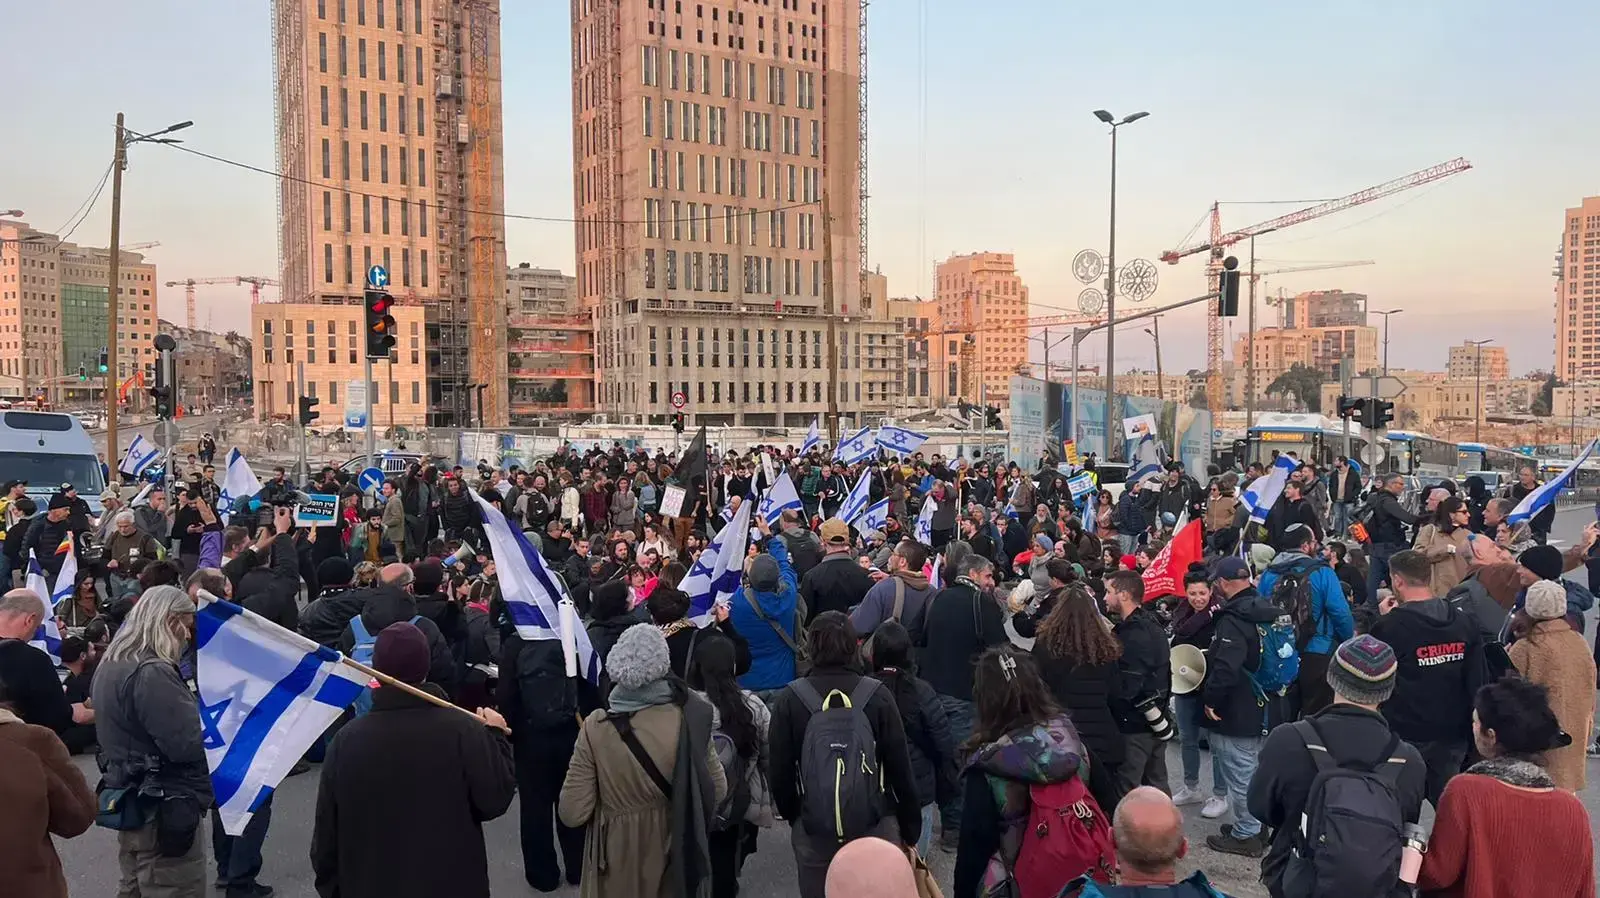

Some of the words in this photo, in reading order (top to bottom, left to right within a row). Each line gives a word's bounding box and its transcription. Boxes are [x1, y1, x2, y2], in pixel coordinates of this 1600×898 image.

[675, 396, 682, 405] 30
[168, 480, 173, 489] 7
[1416, 642, 1465, 658] CRIME
[1417, 652, 1464, 666] MINSTER
